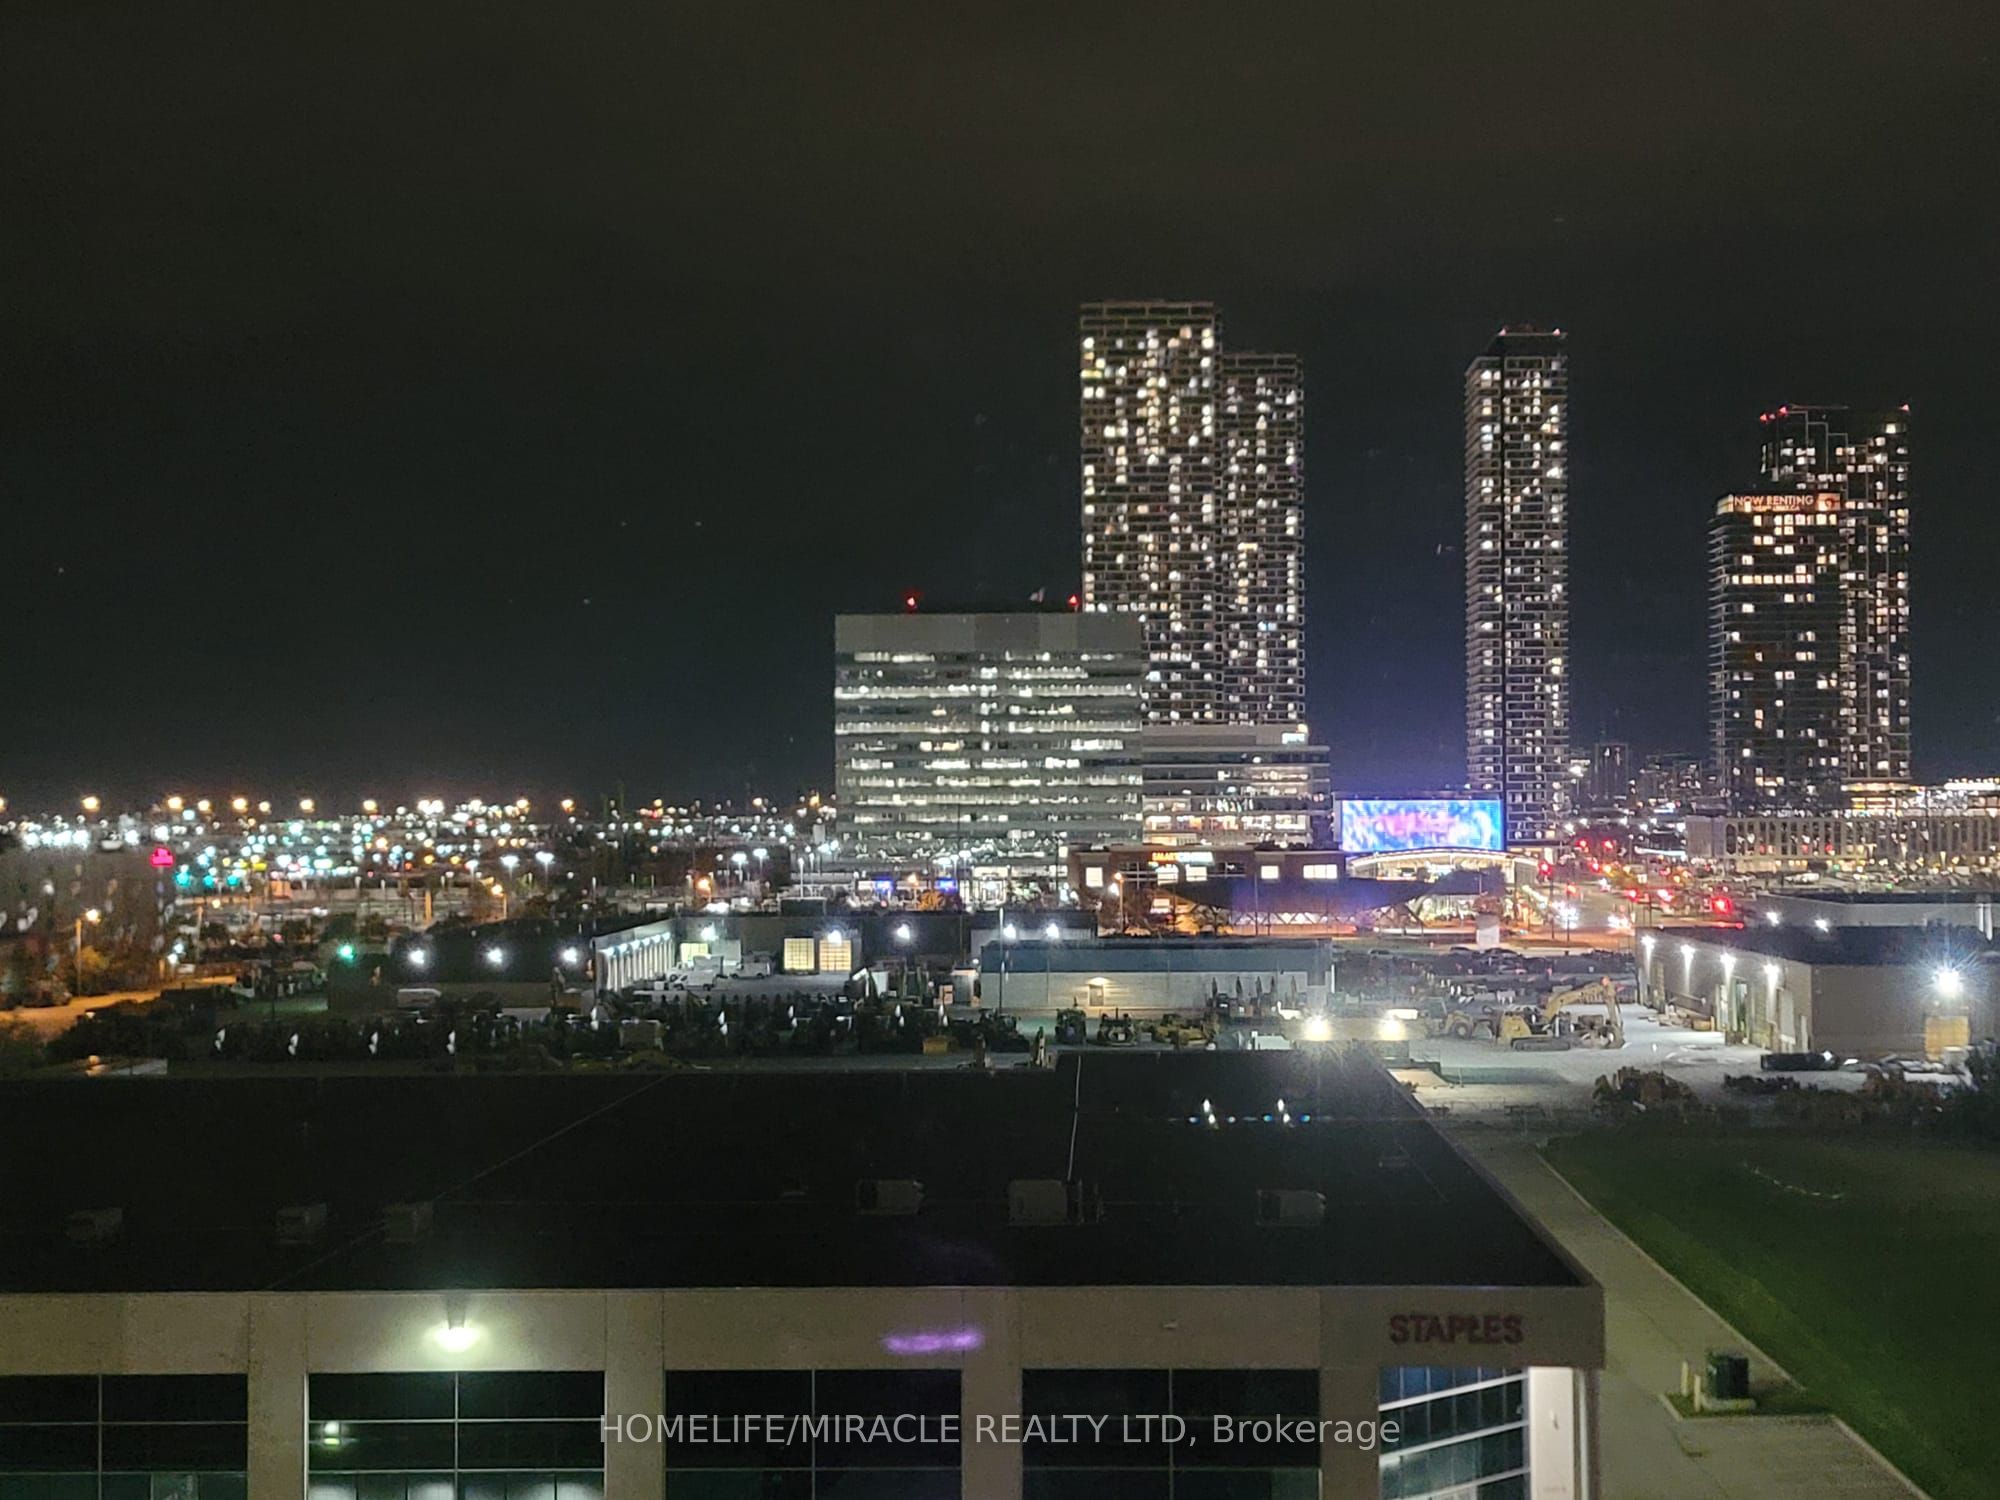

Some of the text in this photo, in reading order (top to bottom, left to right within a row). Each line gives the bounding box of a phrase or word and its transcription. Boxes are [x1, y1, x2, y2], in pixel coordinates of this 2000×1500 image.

[1734, 495, 1814, 506] NOW RENTING
[1390, 1313, 1524, 1344] STAPLES
